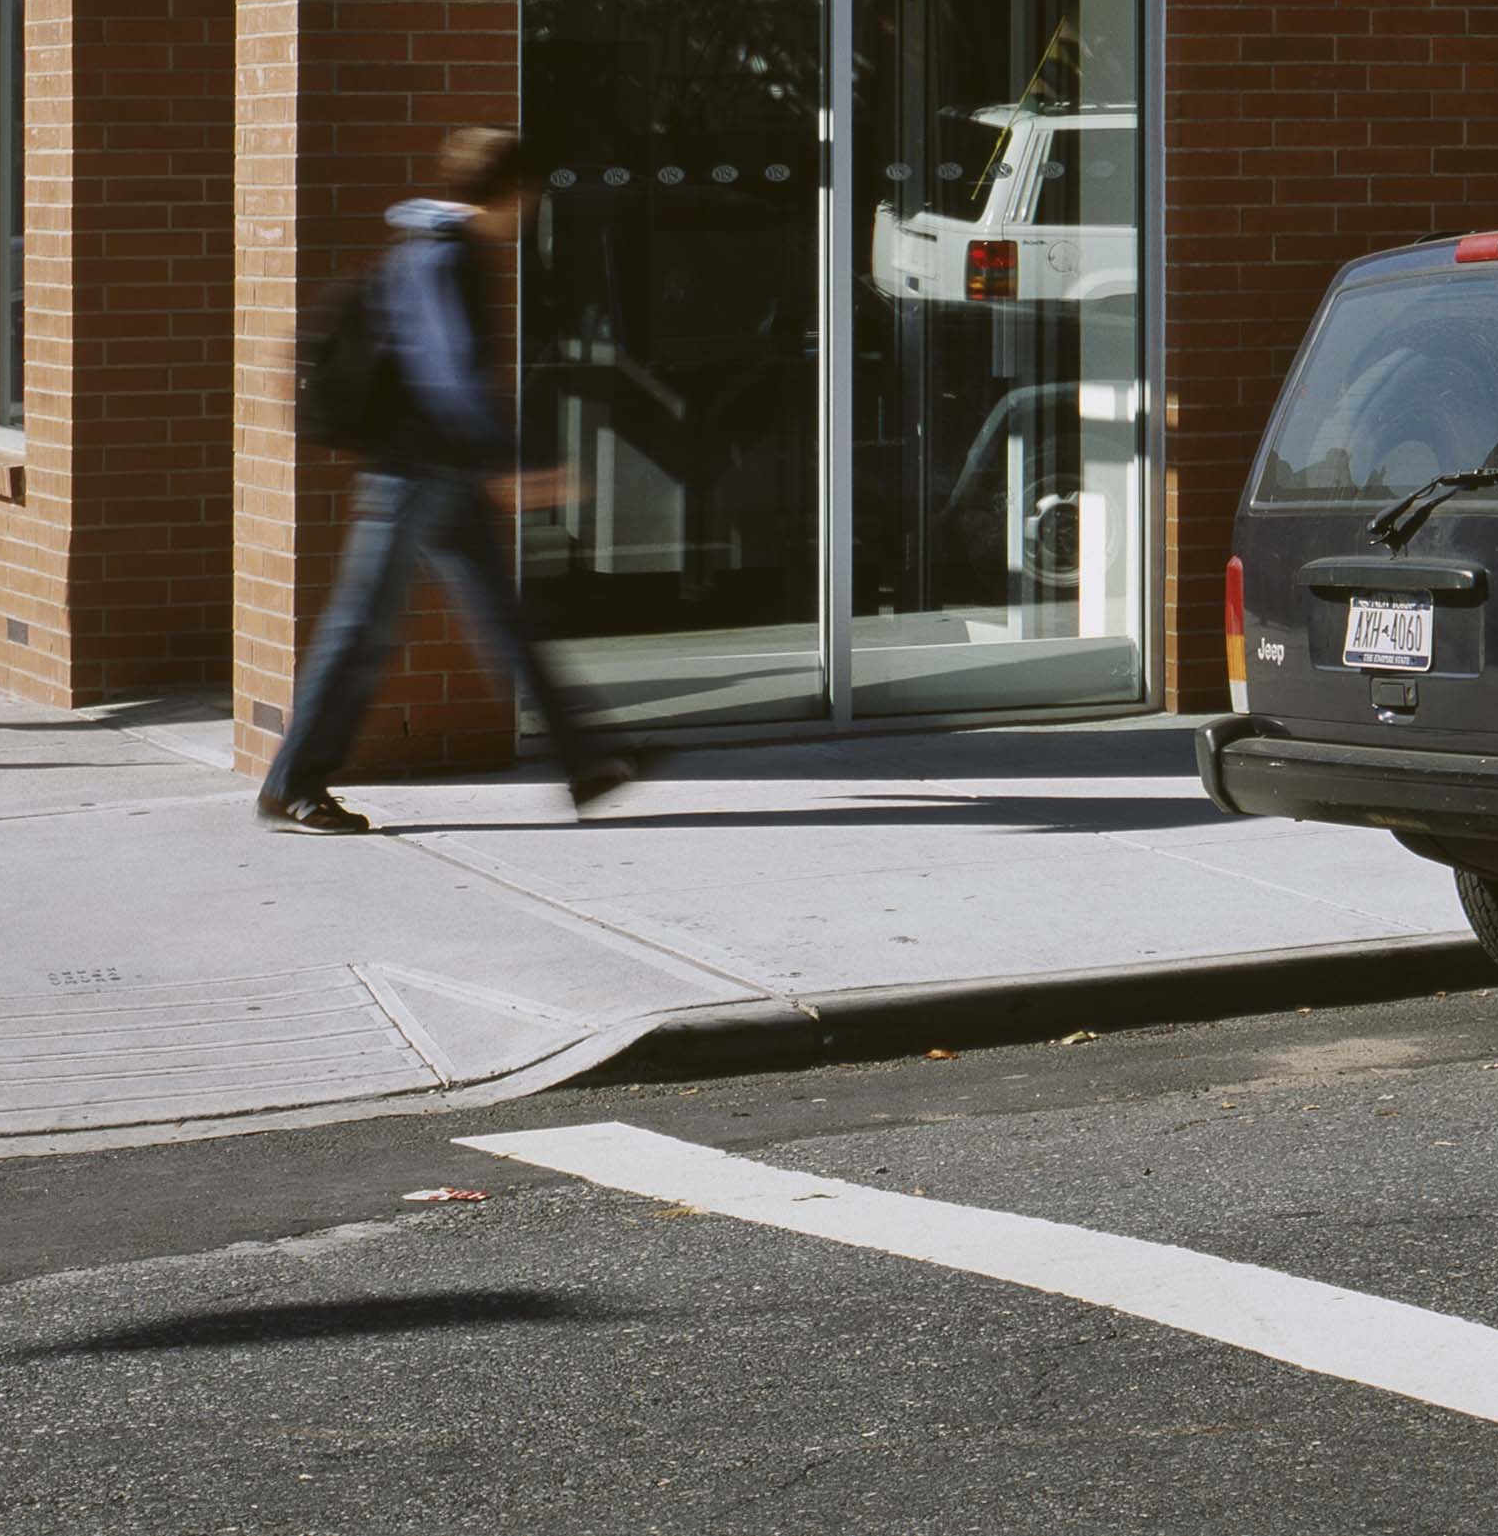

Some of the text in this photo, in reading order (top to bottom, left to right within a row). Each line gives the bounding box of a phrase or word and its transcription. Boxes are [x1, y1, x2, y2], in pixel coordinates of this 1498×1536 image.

[1352, 611, 1423, 651] AXH 4060
[1257, 637, 1285, 666] Jeep
